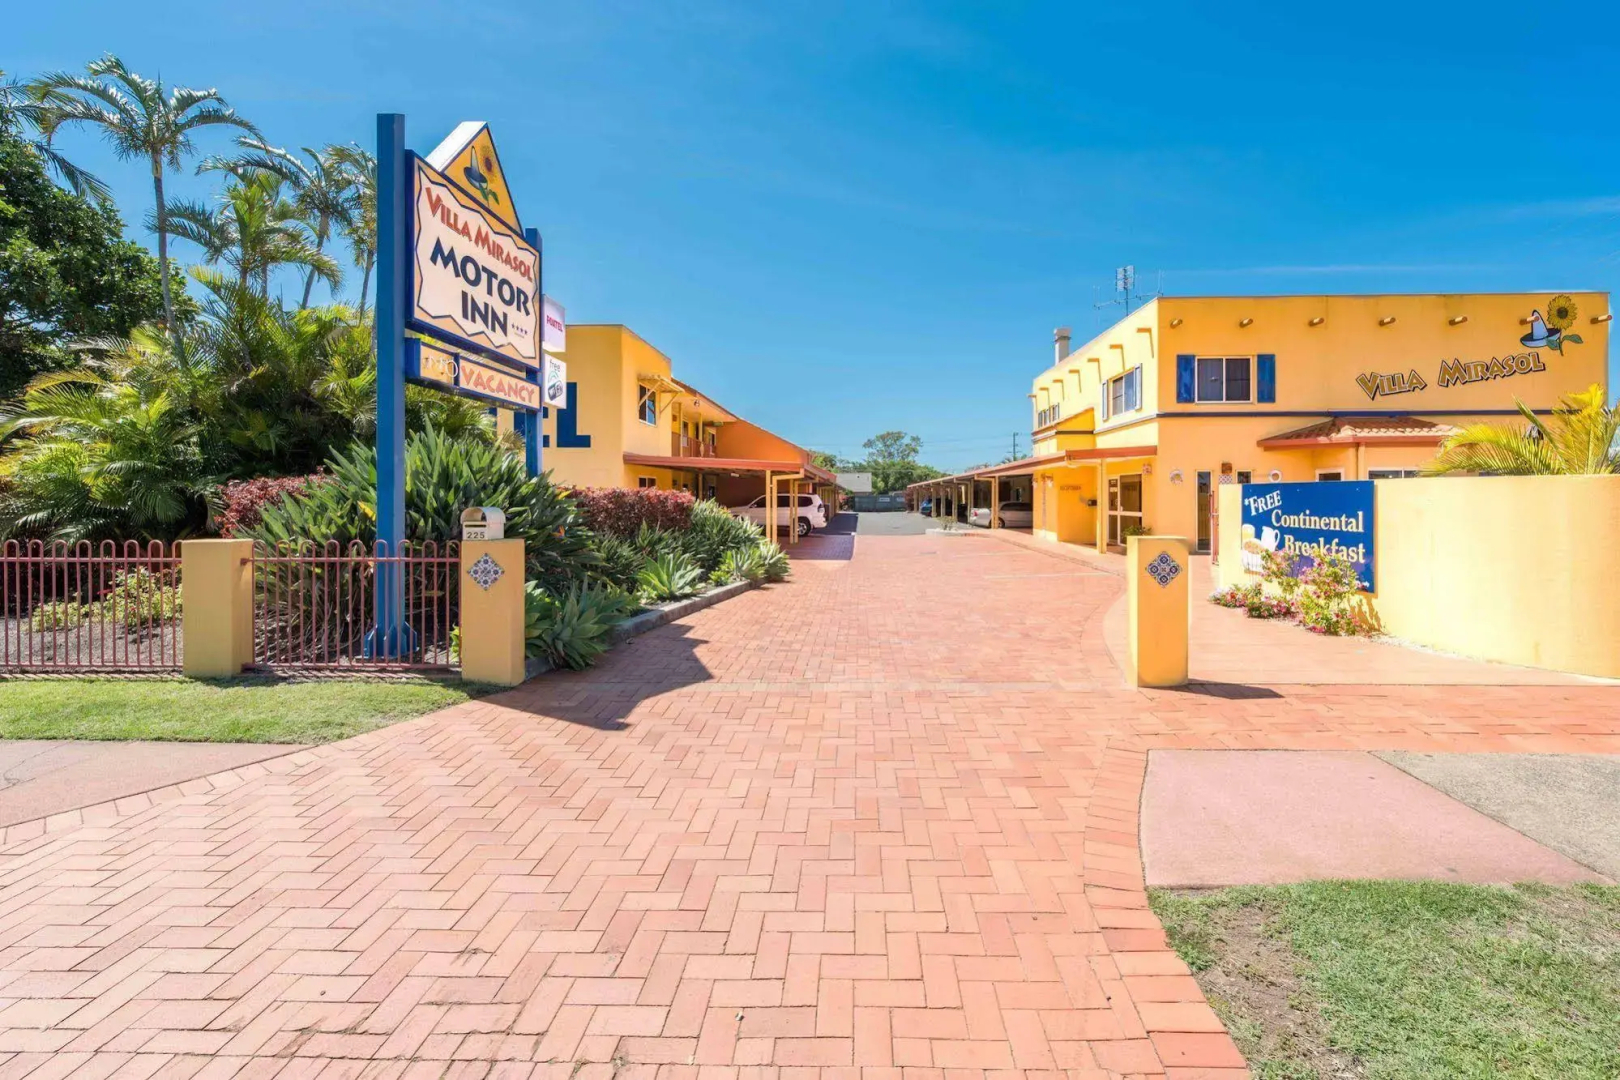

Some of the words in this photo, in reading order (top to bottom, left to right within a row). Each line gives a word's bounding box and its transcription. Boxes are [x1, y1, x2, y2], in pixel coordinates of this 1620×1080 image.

[425, 187, 472, 242] VILLA
[474, 224, 533, 283] MIRASOL
[430, 236, 531, 317] MOTOR
[461, 290, 508, 337] INN
[461, 365, 535, 403] VACANCY
[1355, 369, 1427, 401] VILLA
[1437, 351, 1545, 388] MIRASOL
[466, 531, 485, 539] 225
[1271, 509, 1364, 533] Continental
[1283, 534, 1366, 564] Breakfast
